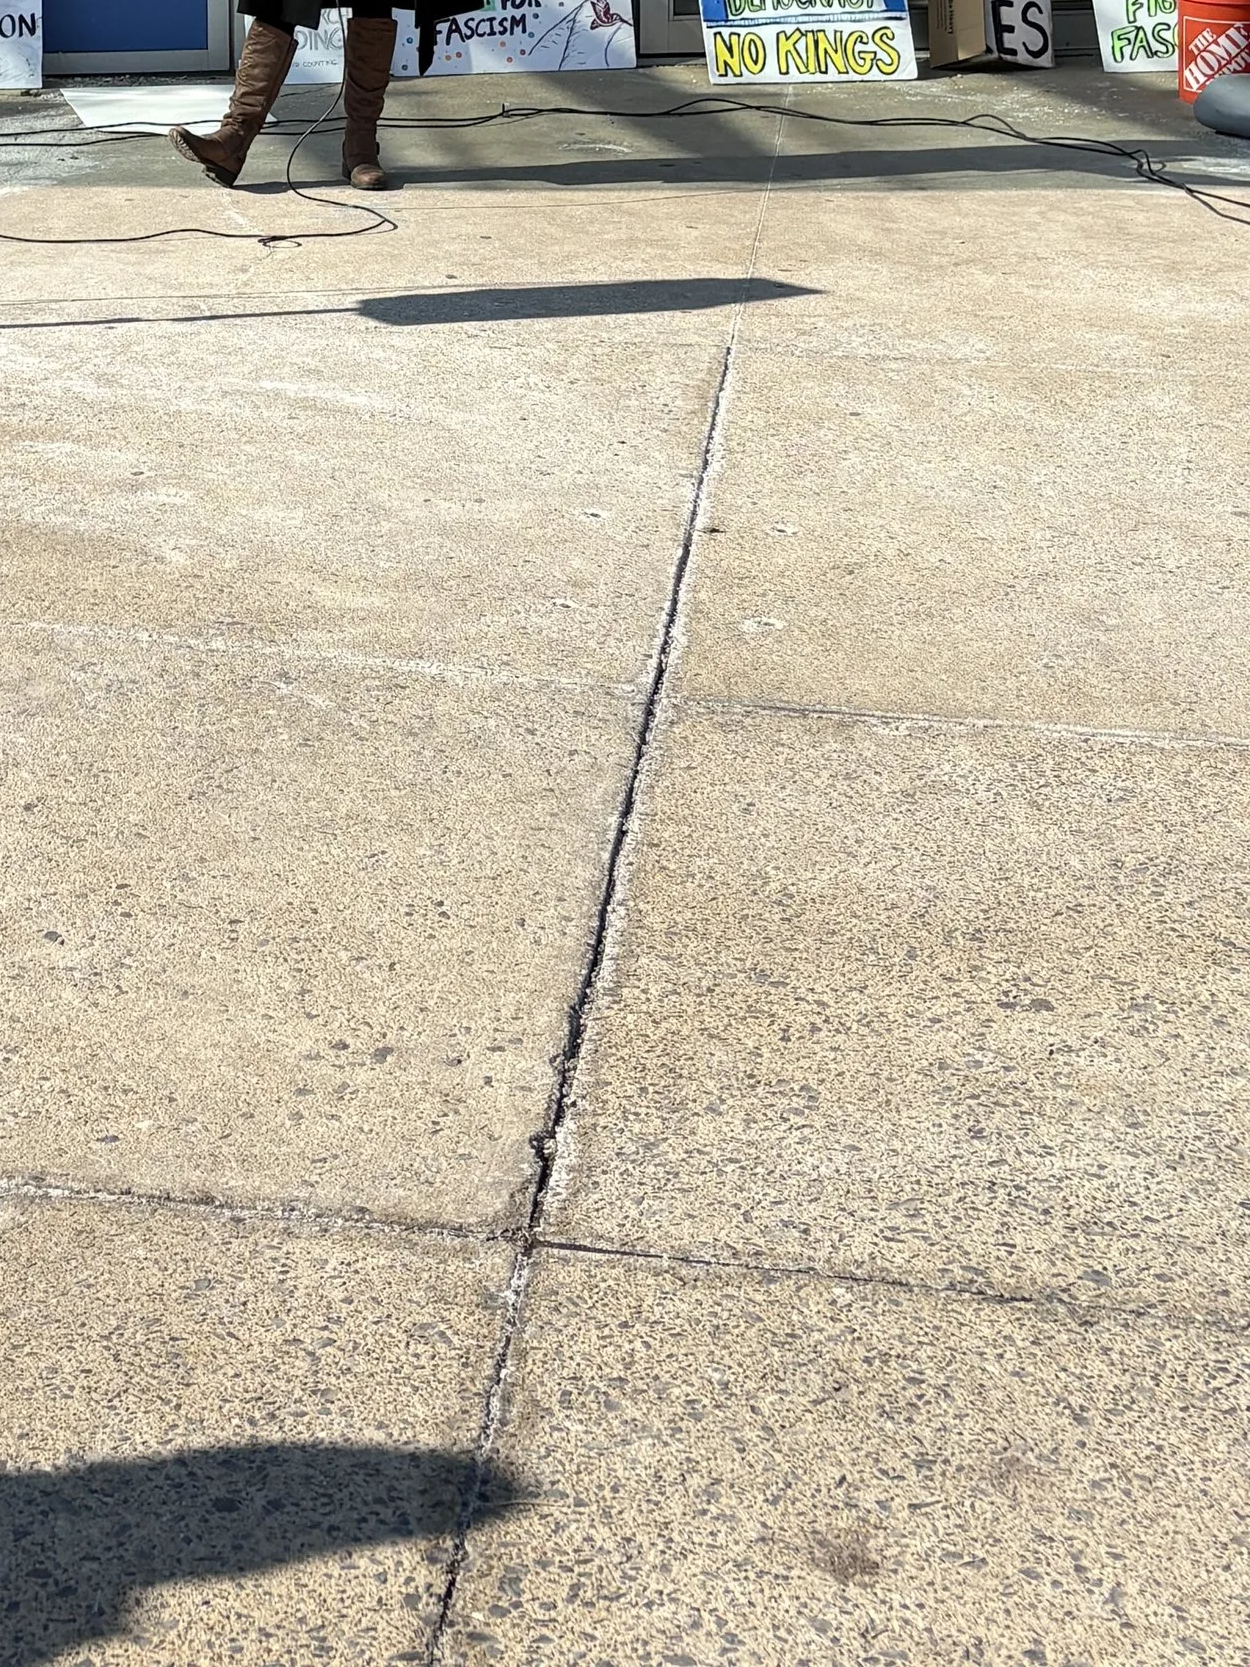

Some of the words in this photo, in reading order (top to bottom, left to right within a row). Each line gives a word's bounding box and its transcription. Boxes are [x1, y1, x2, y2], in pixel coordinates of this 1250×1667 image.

[433, 13, 527, 45] FASCISM
[1188, 27, 1217, 55] THE
[713, 31, 766, 77] NO
[776, 27, 901, 76] KINGS
[1184, 22, 1250, 91] HOME
